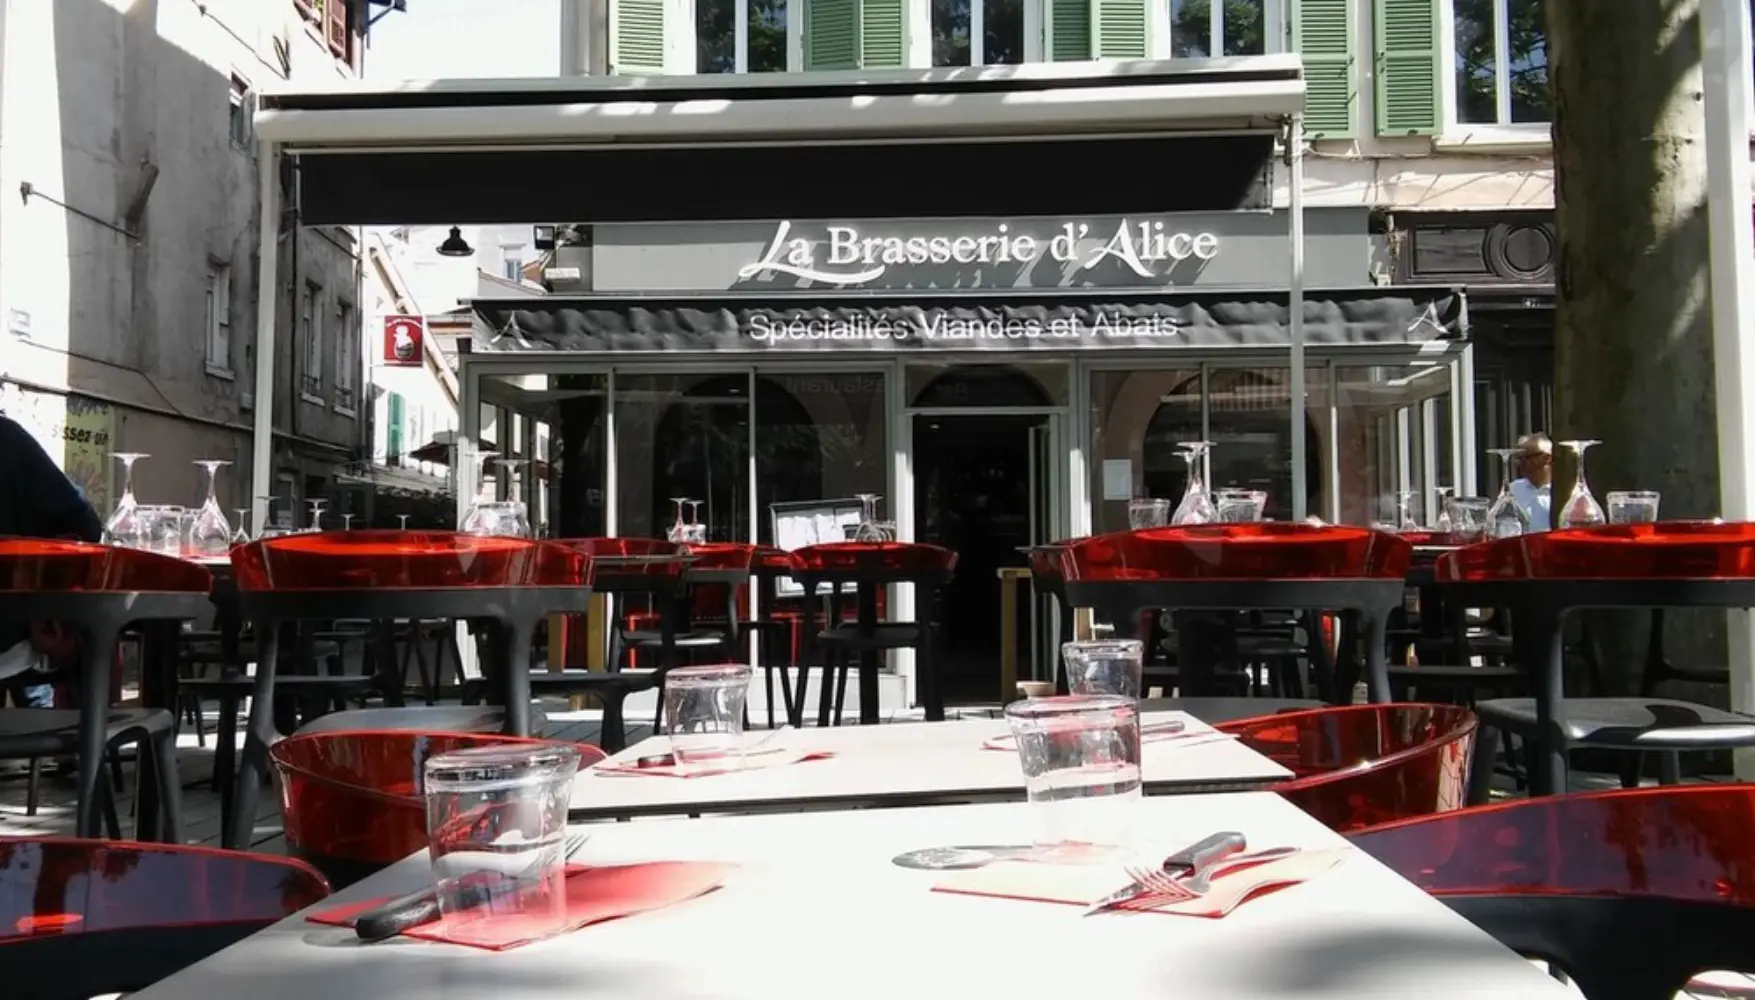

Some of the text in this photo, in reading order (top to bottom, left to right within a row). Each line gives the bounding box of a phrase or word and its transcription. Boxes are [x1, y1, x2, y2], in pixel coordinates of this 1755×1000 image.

[738, 217, 1219, 284] La Brasserie d'Alice
[748, 311, 1180, 344] Spécialités Viandes et Abats
